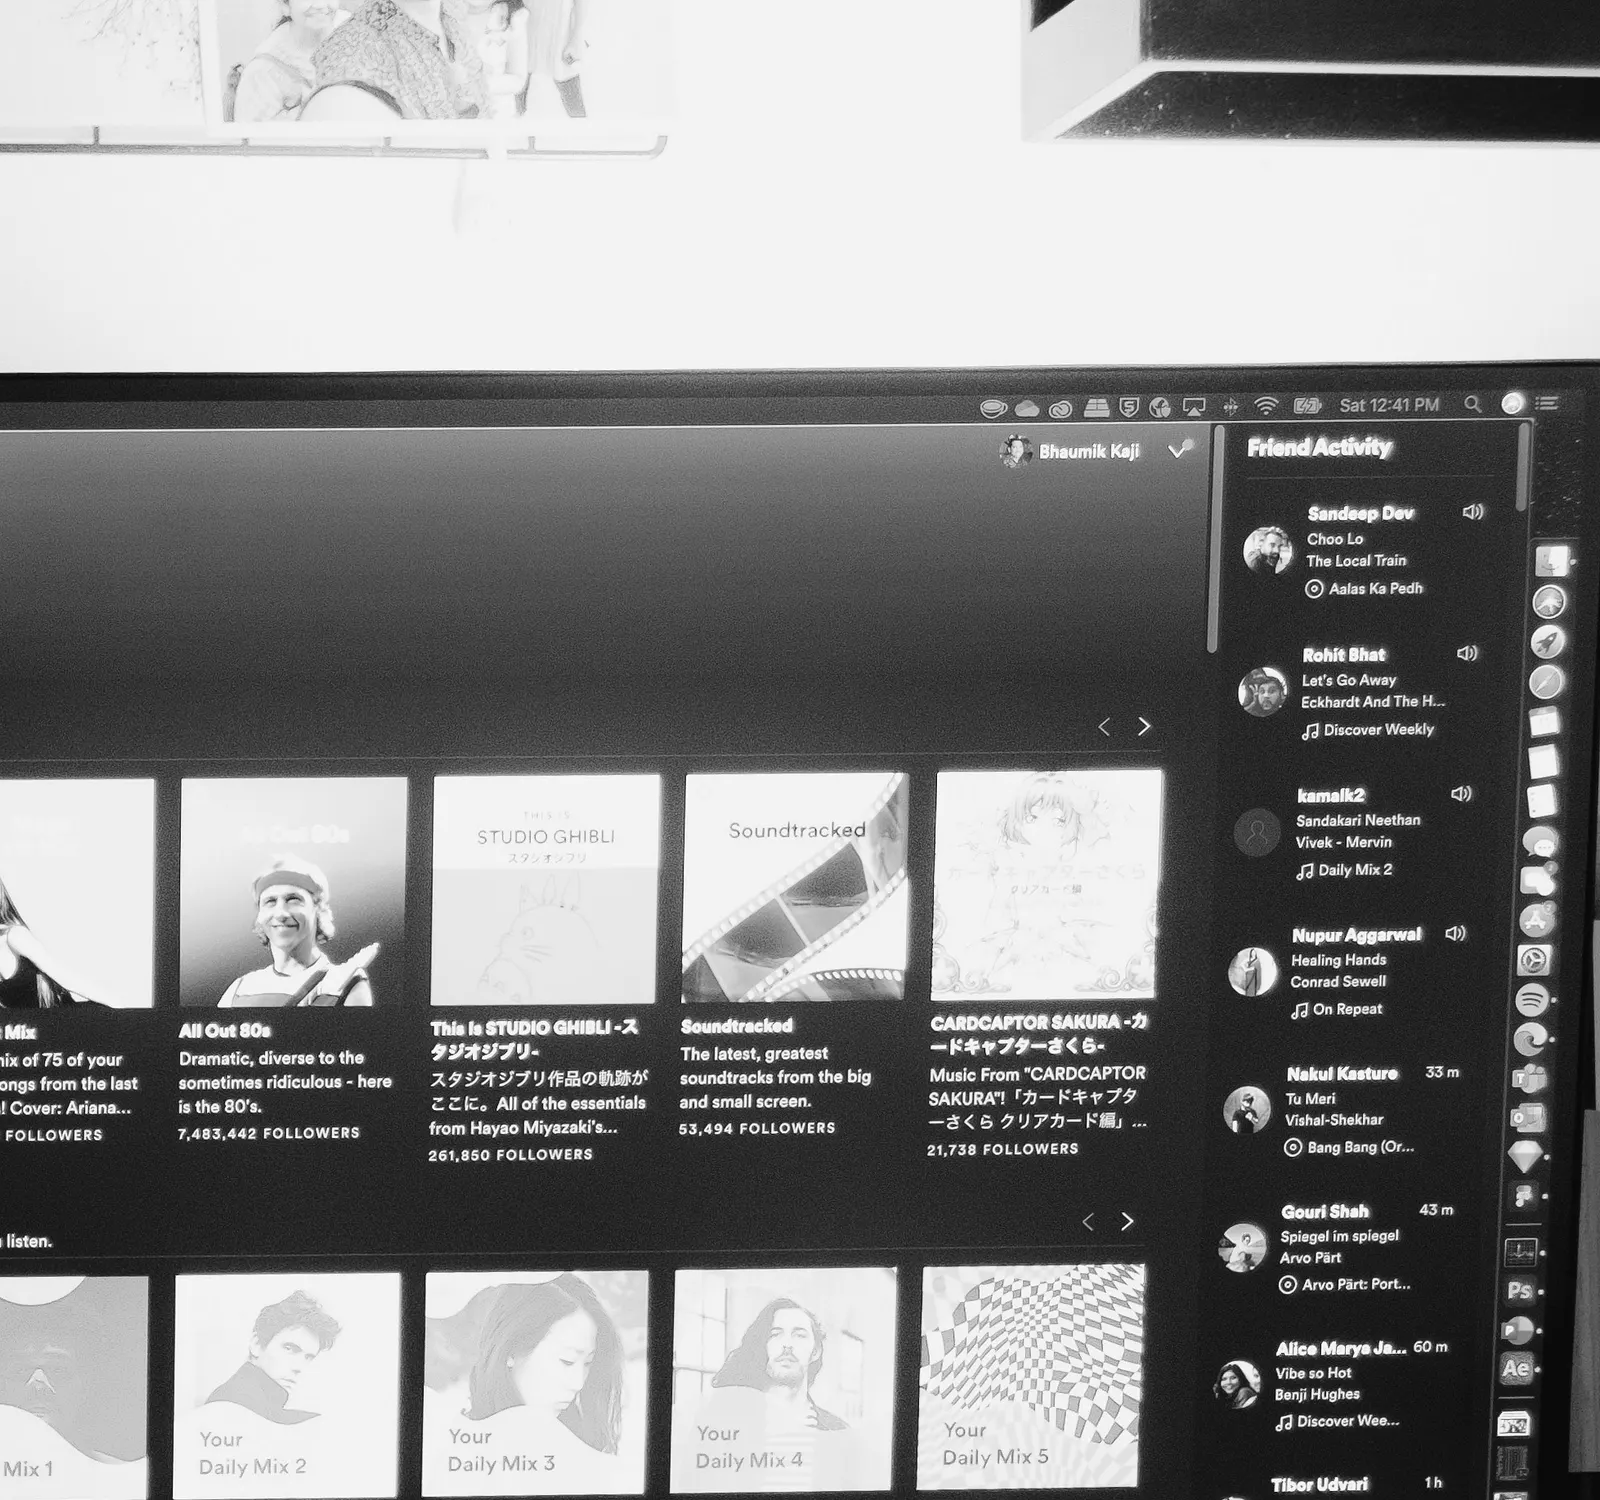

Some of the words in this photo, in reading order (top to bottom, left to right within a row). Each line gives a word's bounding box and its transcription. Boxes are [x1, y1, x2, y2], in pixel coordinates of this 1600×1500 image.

[1340, 398, 1366, 412] Sat
[1370, 398, 1409, 412] 12:41
[1415, 398, 1439, 411] PM
[1040, 444, 1106, 458] Bhaumik
[1111, 443, 1139, 461] Kaji
[1248, 437, 1310, 457] Friend
[1312, 436, 1393, 460] Activity
[1307, 533, 1344, 545] Choo
[1348, 533, 1364, 545] Lo
[1307, 555, 1332, 567] The
[1336, 554, 1371, 567] Local
[1374, 554, 1407, 566] Train
[478, 830, 548, 844] STUDIO
[554, 829, 614, 844] GHIBLI
[730, 822, 866, 838] Soundtracked
[1280, 1252, 1311, 1263] Arvo
[1316, 1252, 1341, 1263] Pärt
[1508, 1282, 1532, 1299] Ps
[1503, 1360, 1529, 1376] Ae
[4, 1461, 39, 1477] Mix
[46, 1461, 52, 1476] 1
